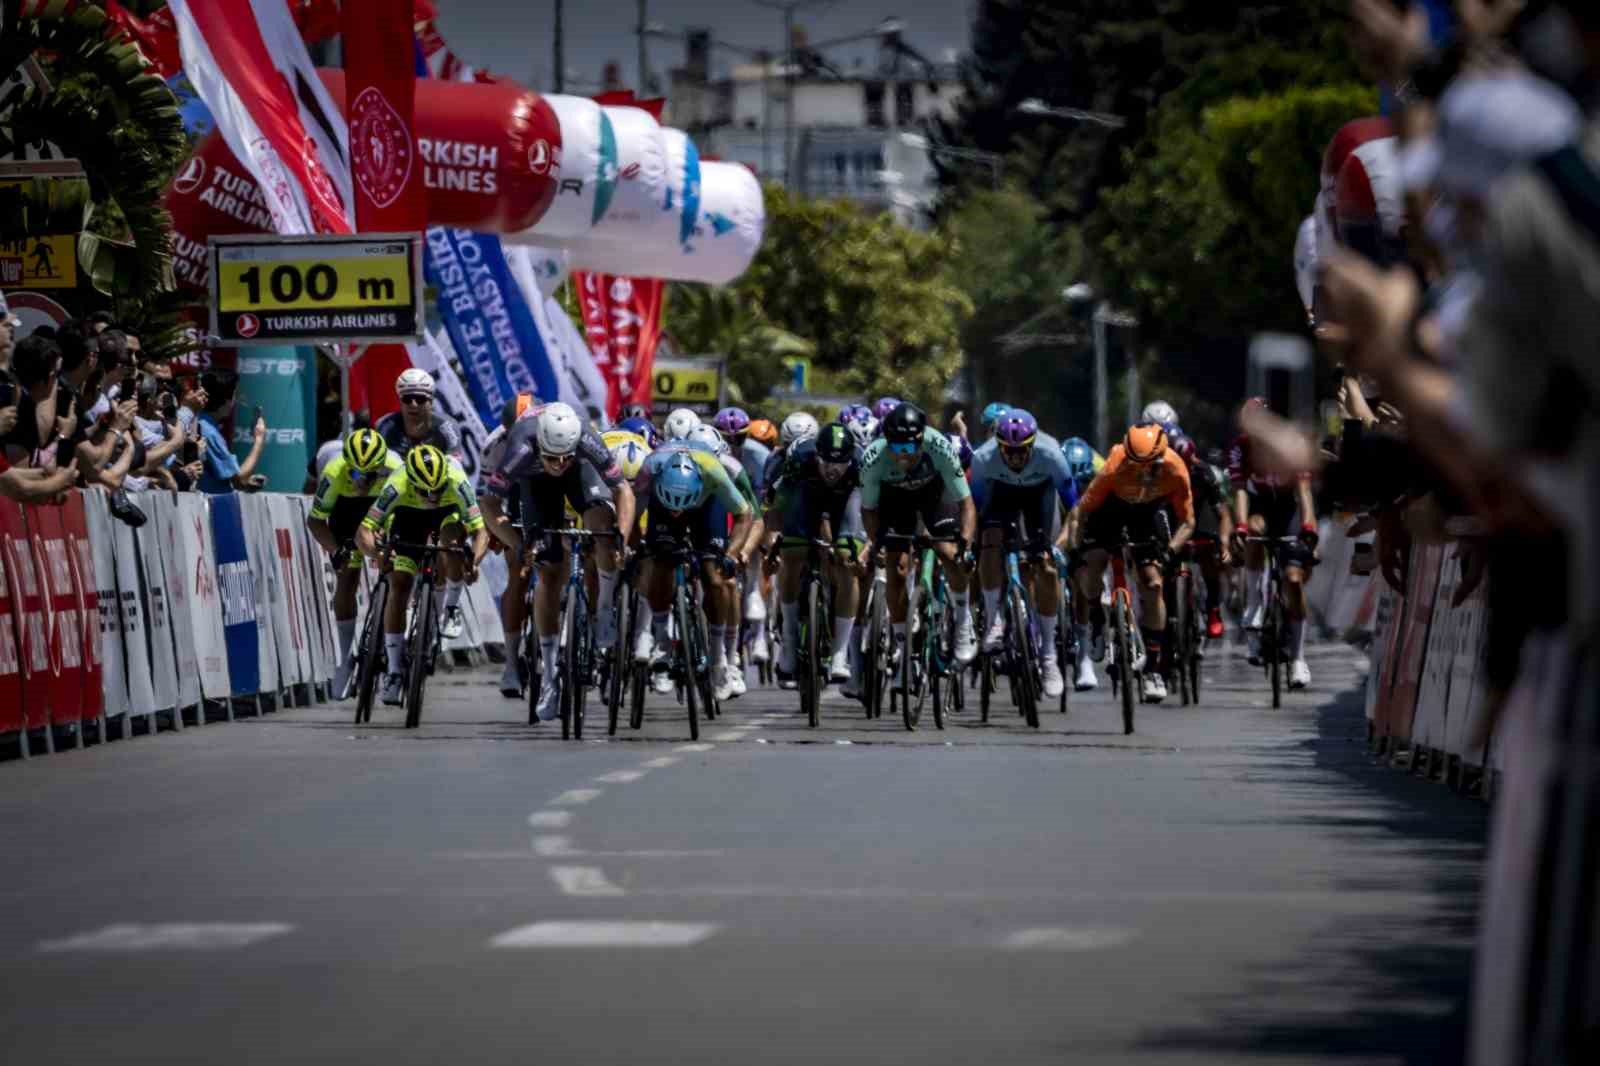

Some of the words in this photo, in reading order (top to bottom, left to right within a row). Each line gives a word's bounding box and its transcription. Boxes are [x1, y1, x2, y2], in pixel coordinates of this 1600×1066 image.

[240, 264, 338, 304] 100
[358, 276, 395, 300] m
[265, 316, 329, 331] TURKISH
[332, 313, 397, 329] AIRLINES
